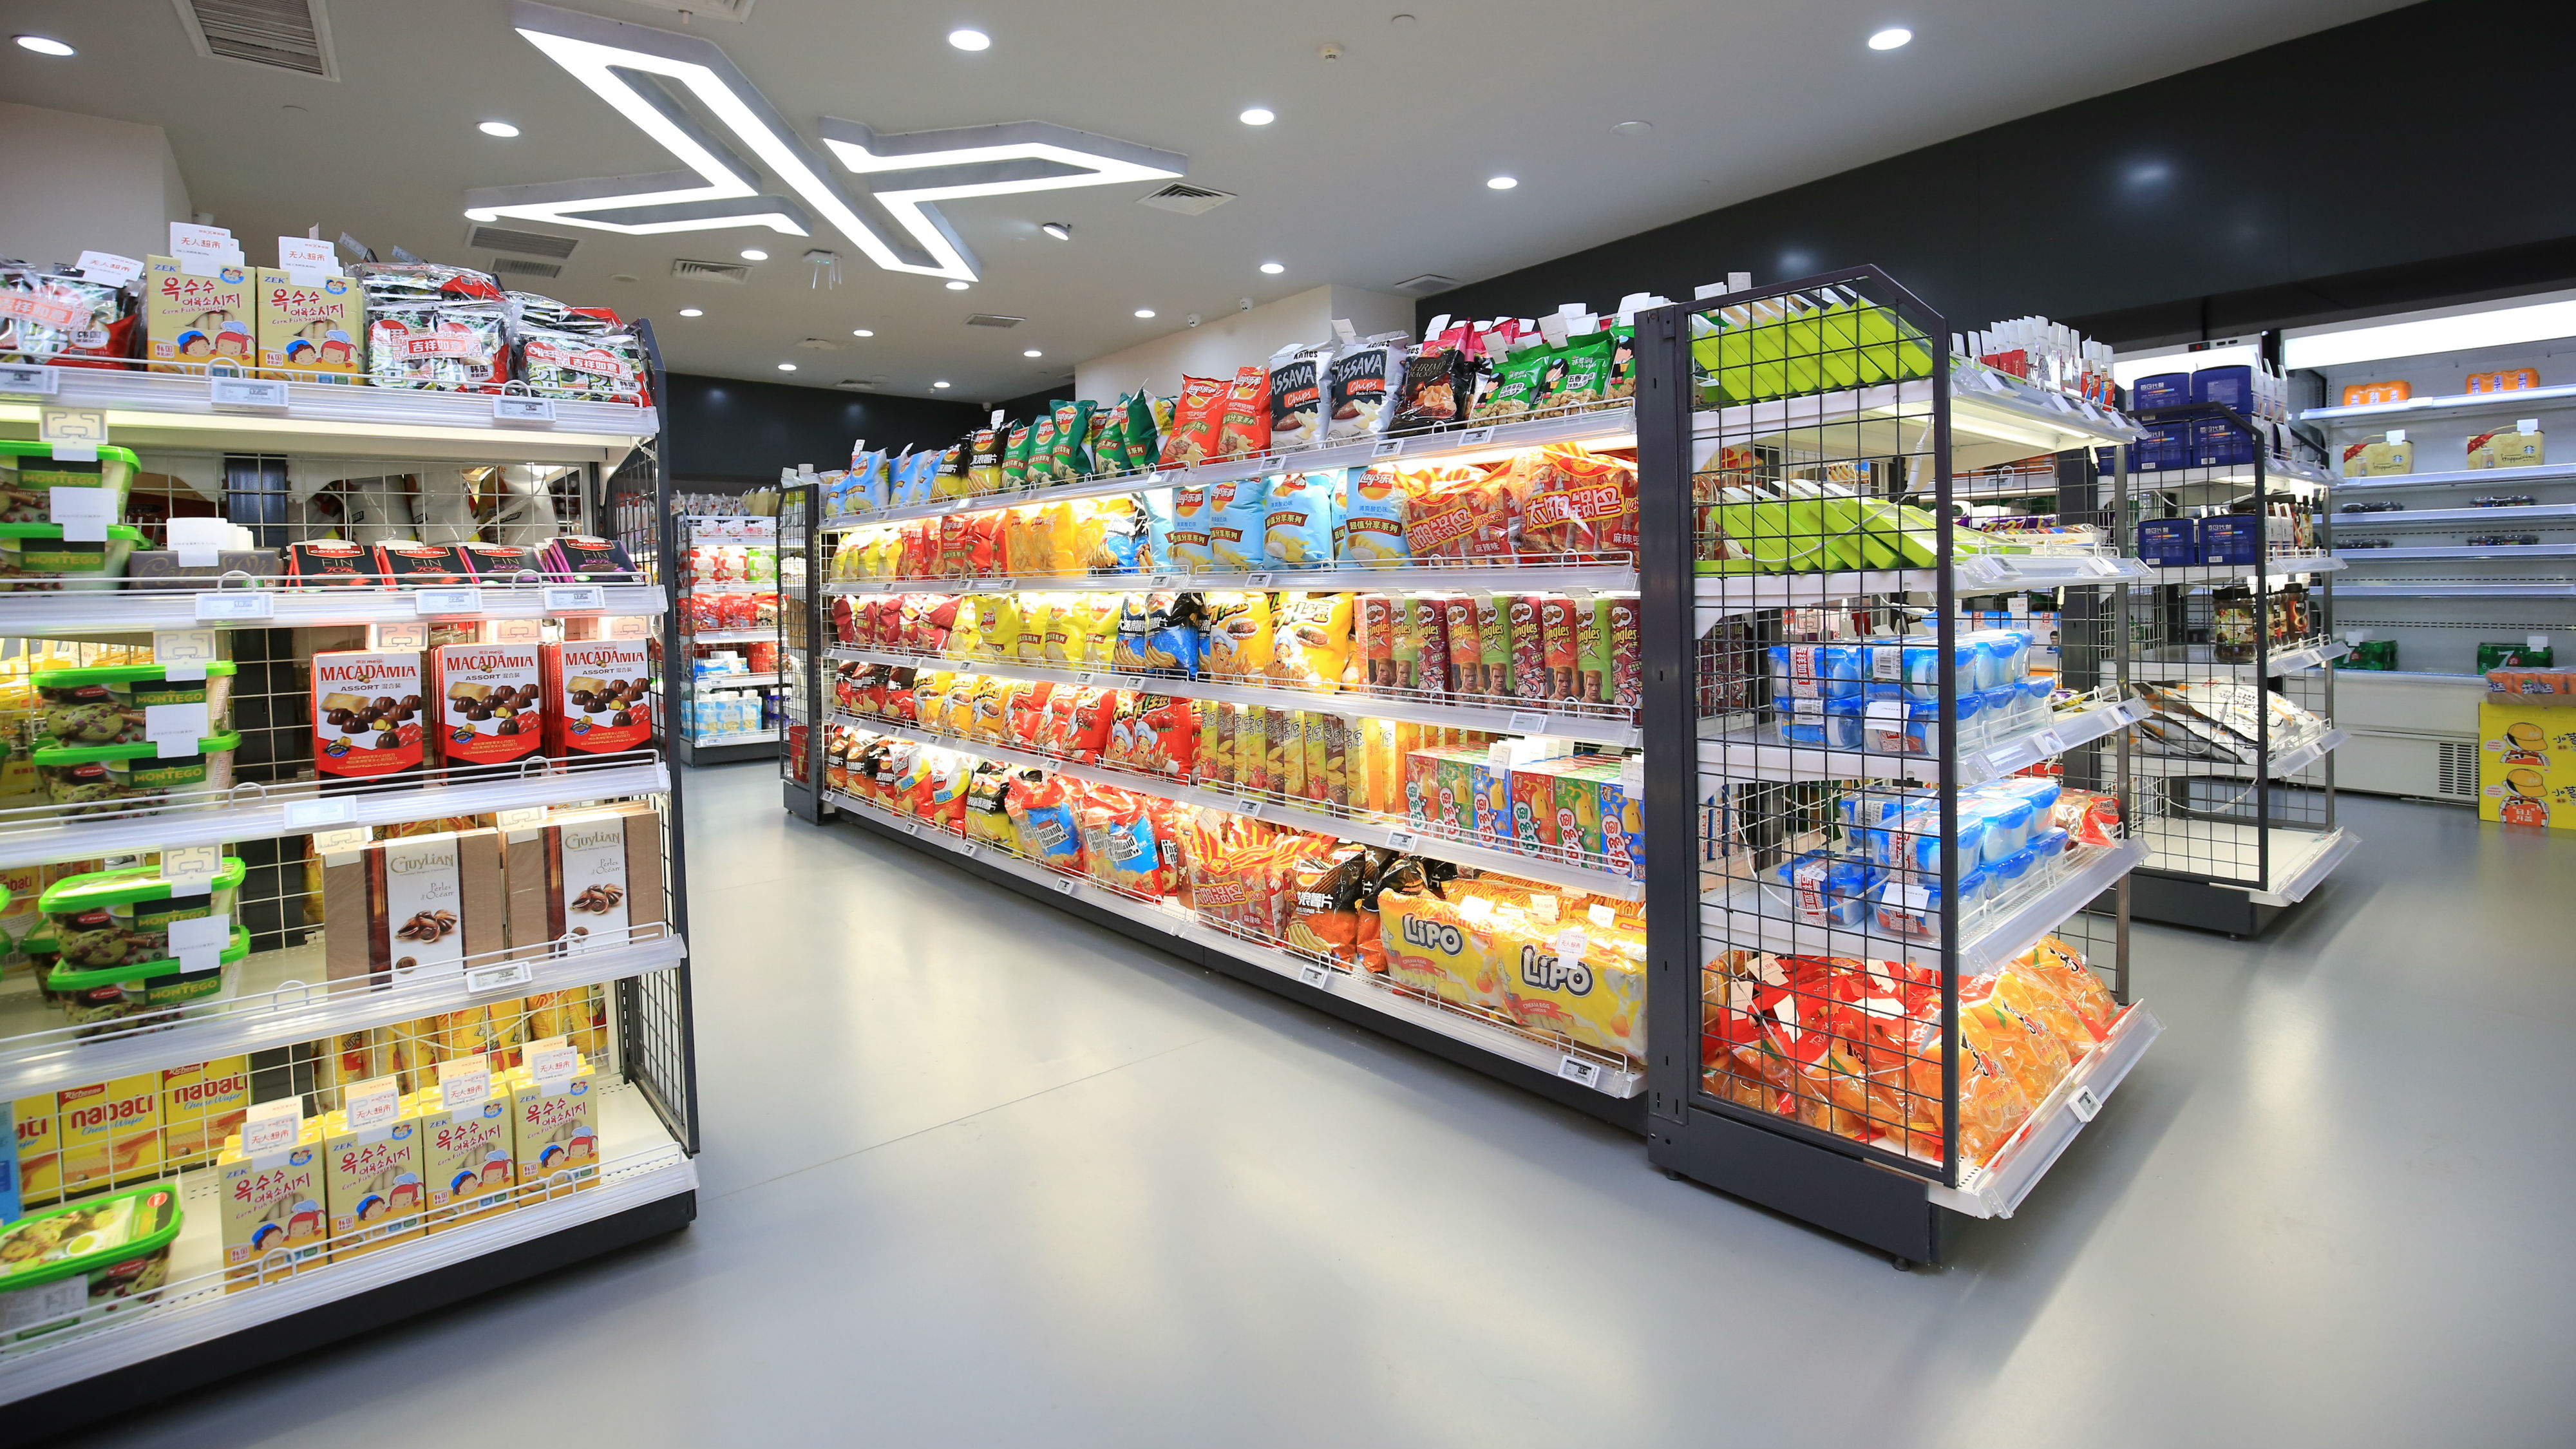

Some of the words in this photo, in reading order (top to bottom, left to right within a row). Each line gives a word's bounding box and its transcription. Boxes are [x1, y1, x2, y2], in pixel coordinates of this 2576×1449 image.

[162, 277, 214, 301] 옥수수
[183, 294, 240, 308] 어육소시지
[271, 289, 320, 312] 옥수수
[291, 303, 343, 318] 어육소시지
[573, 358, 618, 372] 吉祥如意
[1337, 354, 1383, 382] ASSAVA
[1271, 365, 1315, 395] ASSAVA
[1408, 369, 1443, 377] RACKERS
[1350, 380, 1377, 393] Chips
[1288, 391, 1311, 405] Chips
[23, 474, 97, 485] MONTEGO
[1359, 505, 1388, 513] 清爽酸奶味
[1350, 520, 1399, 533] 超值分享系列
[1474, 540, 1501, 554] 麻辣味
[26, 556, 100, 565] MONTEGO
[582, 551, 609, 559] FIN
[1367, 623, 1390, 638] ringles
[1392, 625, 1411, 638] ringles
[1417, 625, 1439, 638] ingles
[1482, 621, 1504, 639] ringles
[1544, 625, 1569, 640] ringles
[1578, 627, 1600, 643] ringles
[1613, 628, 1637, 643] ringles
[447, 656, 534, 670] MACADAMIA
[565, 650, 644, 665] MACADAMIA
[321, 665, 417, 681] MACADAMIA
[136, 692, 203, 704] MONTEGO
[134, 768, 202, 782] MONTEGO
[600, 858, 618, 867] Perles
[431, 883, 451, 892] Perles
[149, 980, 217, 999] MONTEGO
[174, 1072, 248, 1104] nabati
[214, 1092, 242, 1103] Wafer
[71, 1094, 155, 1128] nabati
[526, 1098, 566, 1125] 옥수수
[542, 1102, 586, 1126] 어육소시지
[430, 1119, 448, 1128] ZEK
[436, 1121, 479, 1151] 옥수수
[454, 1125, 500, 1152] 어육소시지
[334, 1142, 353, 1151] ZEK
[341, 1144, 387, 1175] 옥수수
[360, 1146, 410, 1175] 어육소시지
[226, 1169, 247, 1179] ZEK
[234, 1170, 285, 1202] 옥수수
[255, 1173, 310, 1203] 어육소시지
